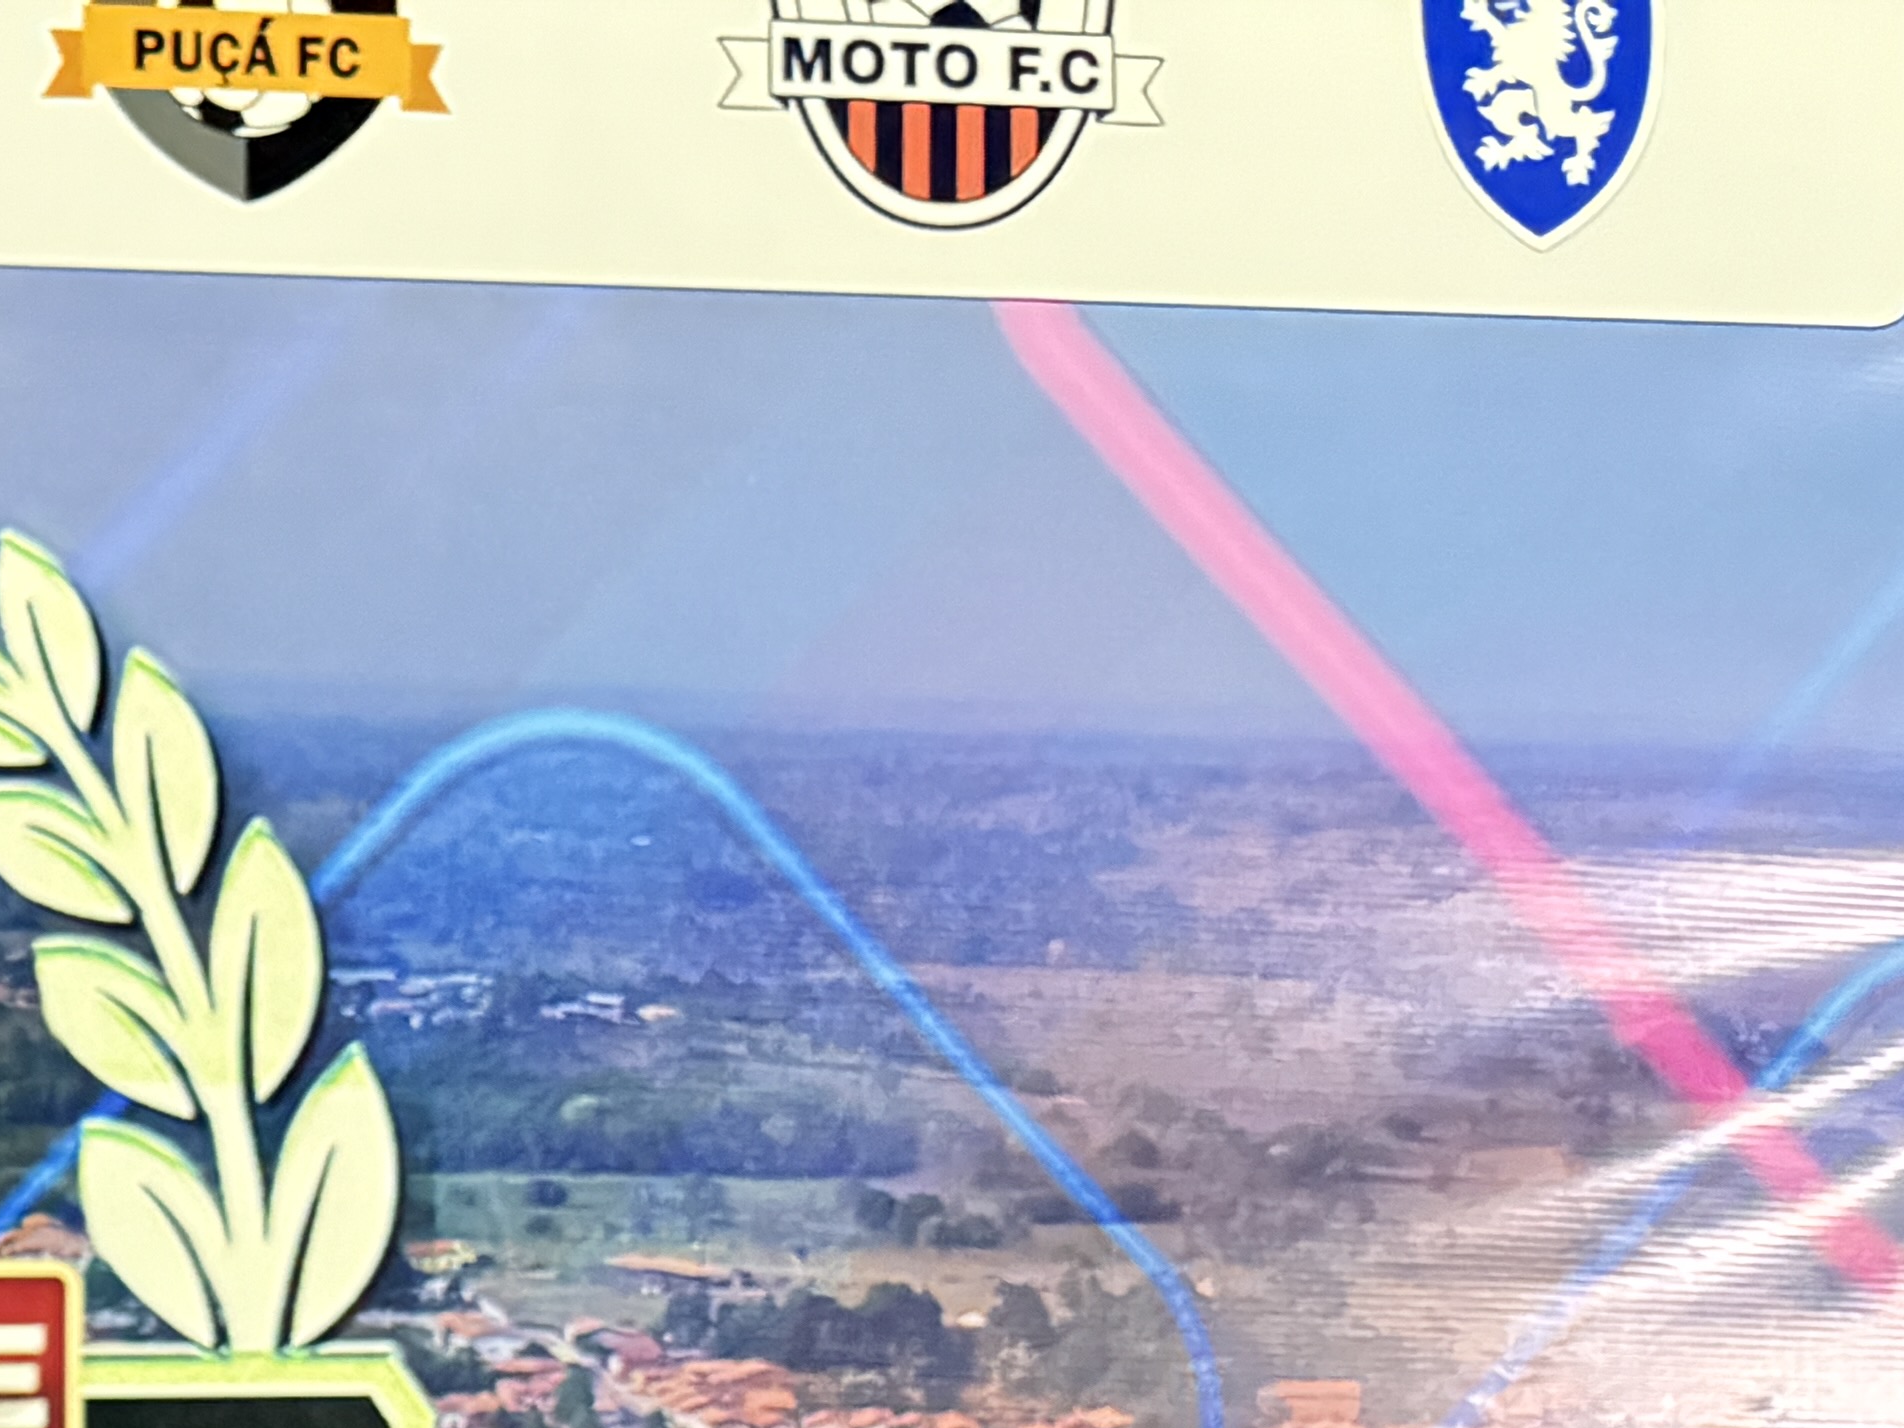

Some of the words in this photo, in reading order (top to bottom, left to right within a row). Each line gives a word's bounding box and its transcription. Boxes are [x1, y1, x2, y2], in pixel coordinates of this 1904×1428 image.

[134, 14, 279, 84] PUÇÁ
[298, 35, 362, 78] FC
[781, 36, 981, 91] MOTO
[1007, 46, 1102, 98] F.C
